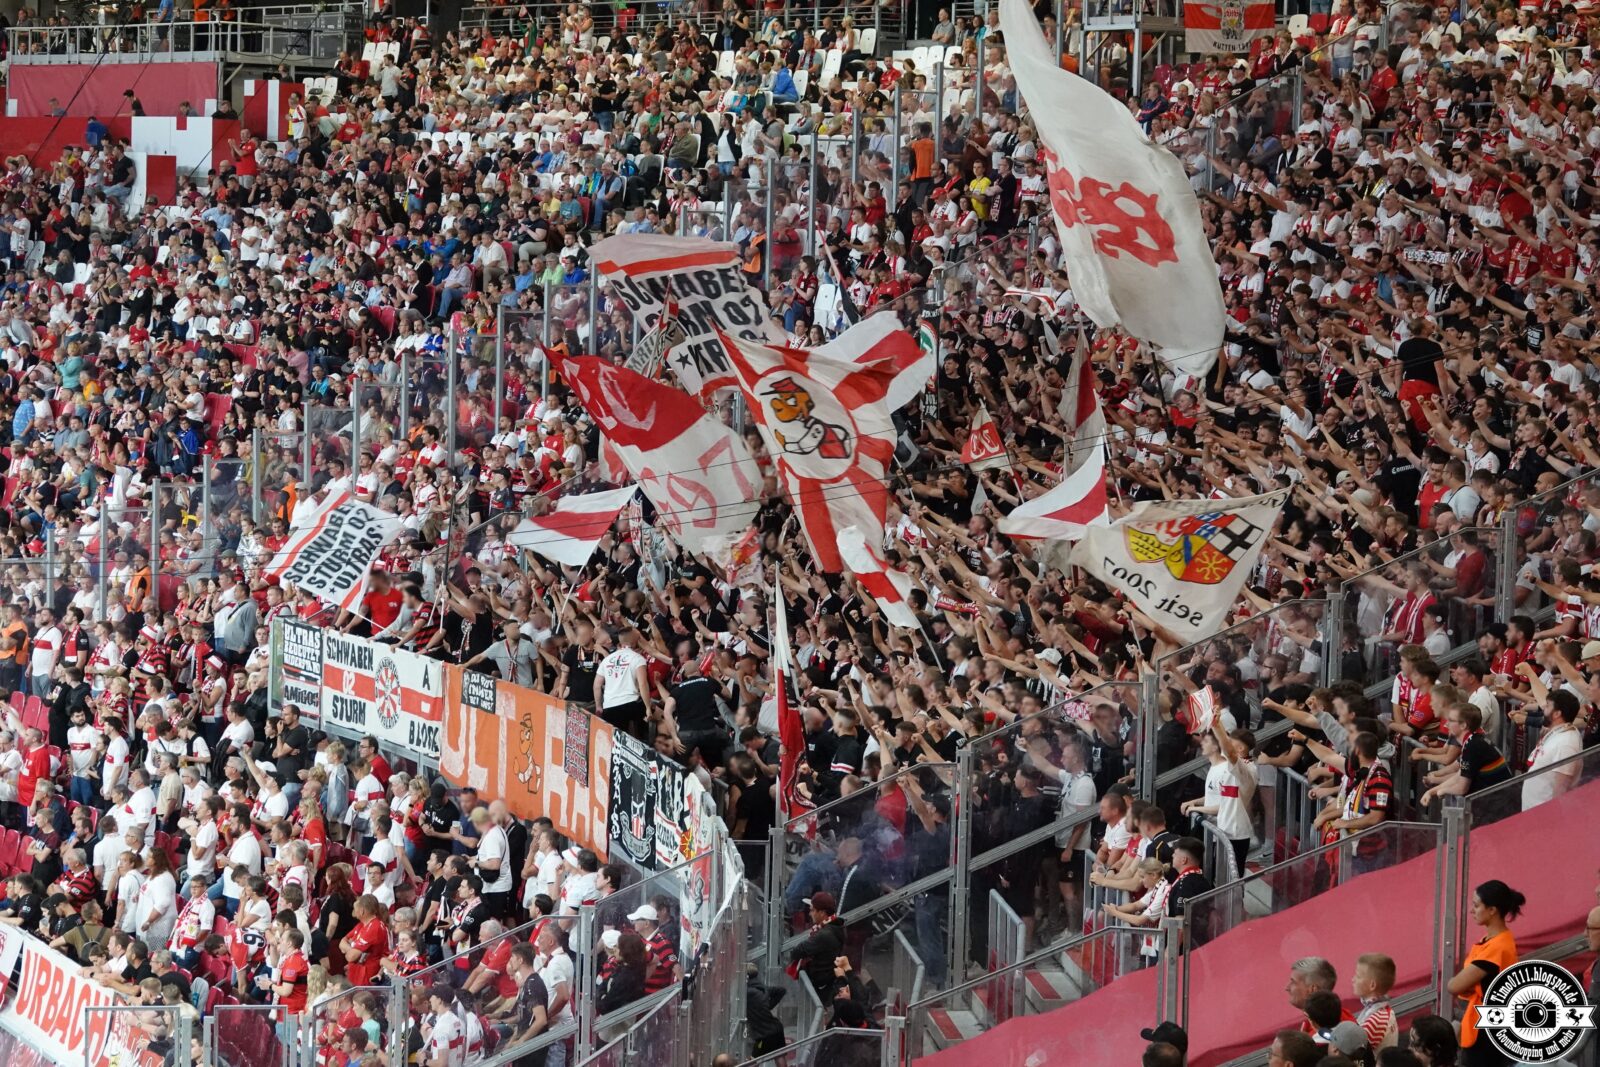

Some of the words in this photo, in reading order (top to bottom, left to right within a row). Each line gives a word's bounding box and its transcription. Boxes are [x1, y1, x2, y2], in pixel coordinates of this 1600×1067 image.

[307, 530, 357, 589] STURM
[332, 526, 384, 590] ULTRAS
[284, 622, 321, 649] ULTRAS
[326, 635, 374, 672] SCHWABEN
[342, 671, 356, 697] 02
[422, 663, 431, 691] A
[332, 694, 367, 726] STURM
[15, 947, 111, 1066] URBACH
